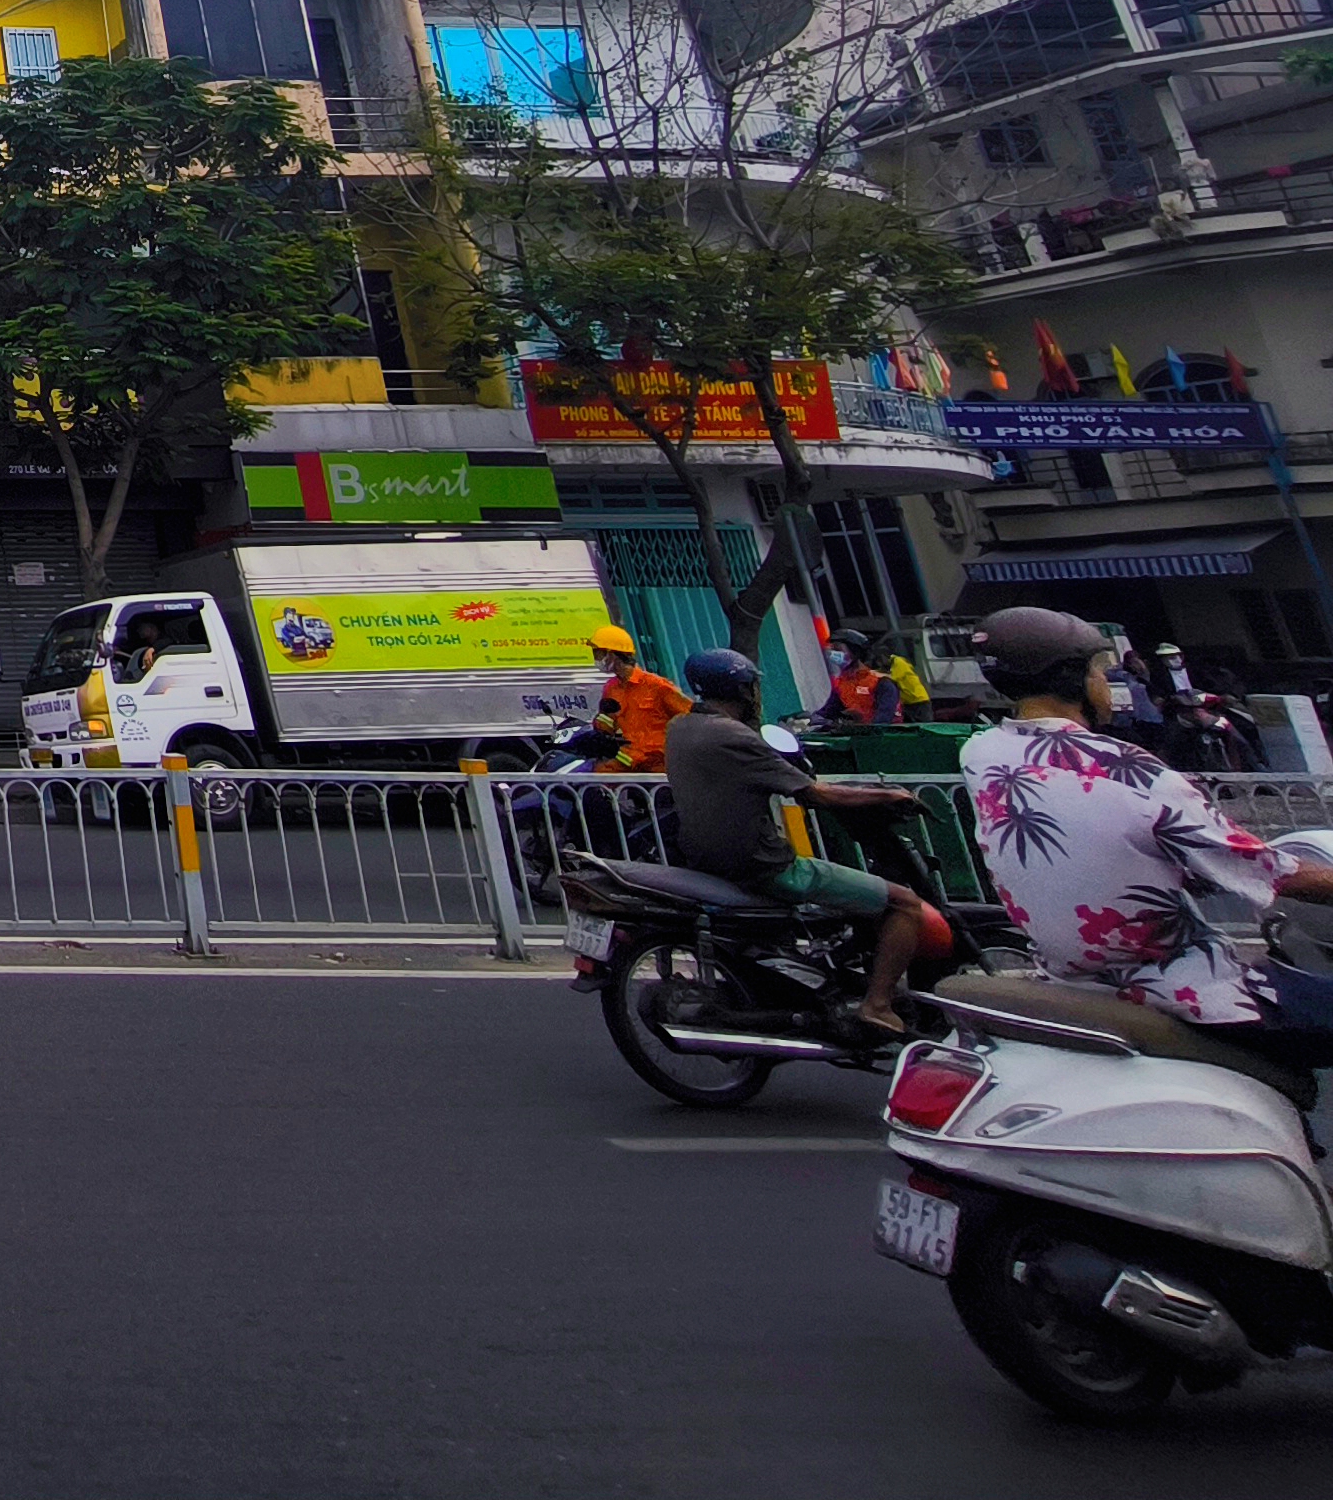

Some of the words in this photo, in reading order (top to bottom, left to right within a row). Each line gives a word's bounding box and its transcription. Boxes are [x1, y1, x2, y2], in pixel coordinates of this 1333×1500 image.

[1061, 413, 1096, 423] PHỐ
[995, 423, 1070, 437] PHỐ
[1080, 425, 1155, 437] VĂN
[1168, 424, 1245, 437] HÓA
[380, 463, 471, 498] mart
[339, 613, 403, 628] CHUYỂN
[407, 612, 441, 627] NHÀ
[366, 635, 404, 648] TRỌN
[408, 632, 432, 647] GÓI
[435, 634, 461, 645] 24H
